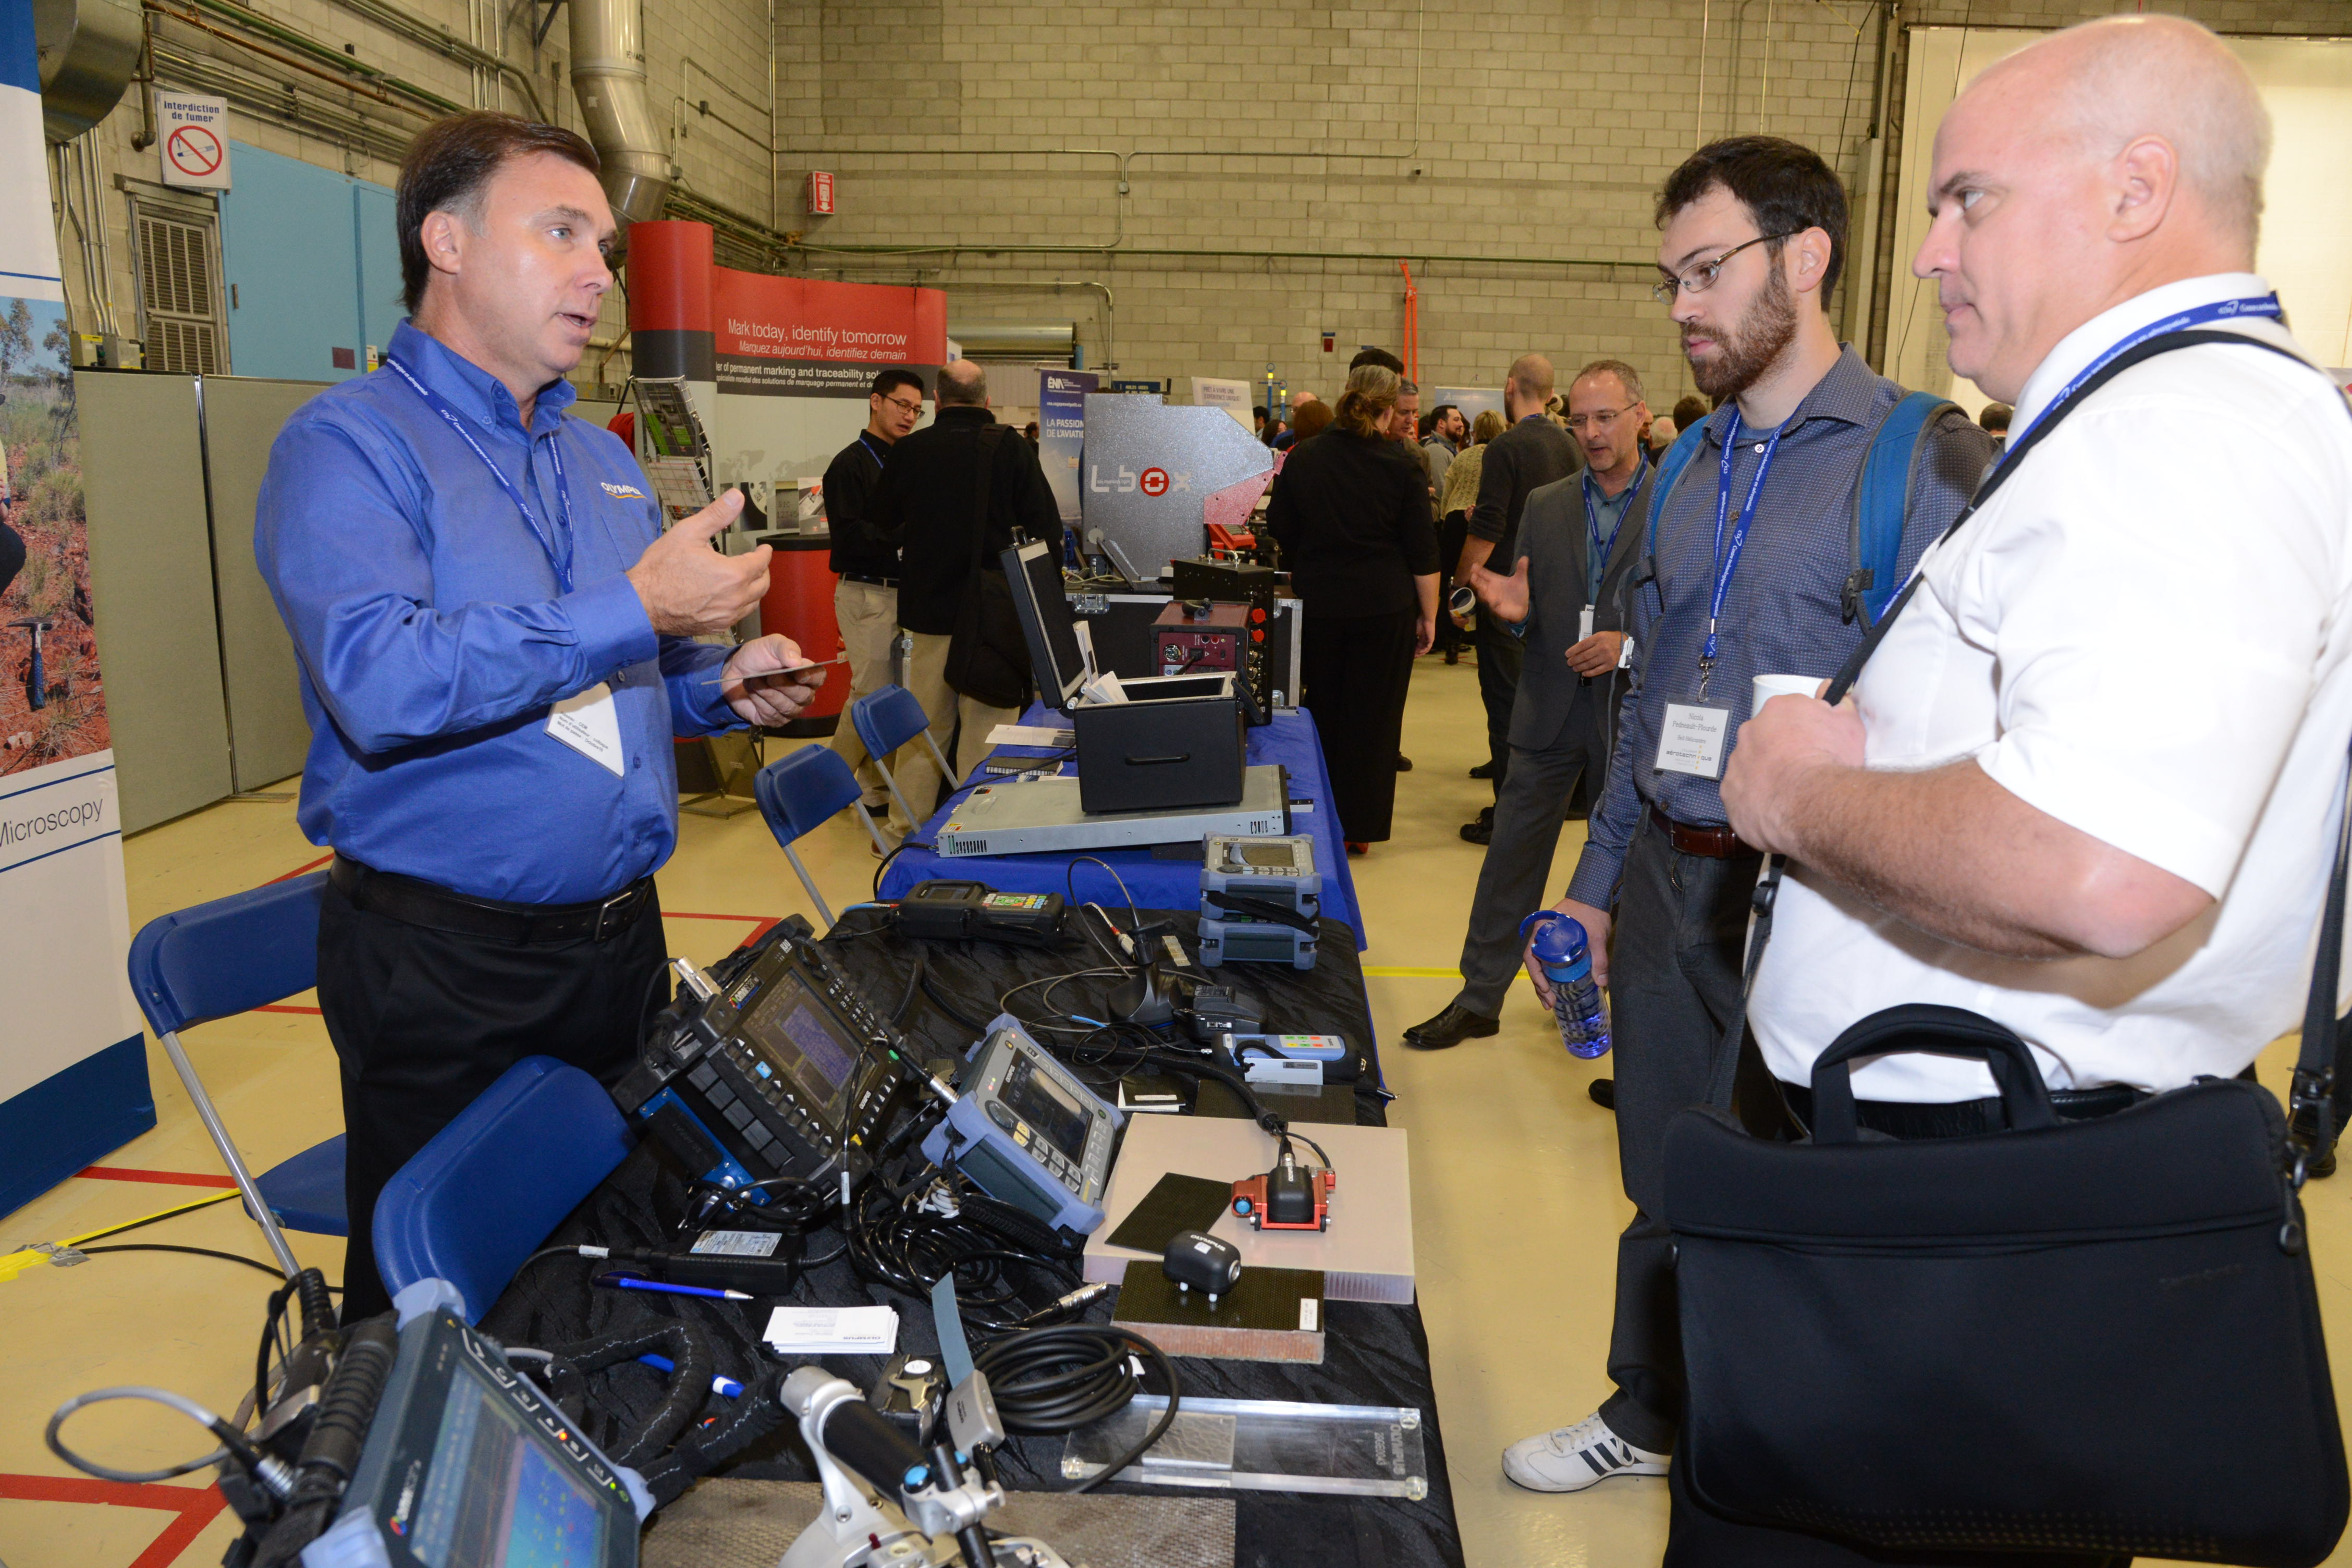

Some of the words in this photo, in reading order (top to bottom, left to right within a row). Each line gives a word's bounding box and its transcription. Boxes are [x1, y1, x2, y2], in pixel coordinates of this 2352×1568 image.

[164, 101, 219, 114] Interdiction
[172, 111, 182, 120] de
[186, 113, 214, 123] fumer
[728, 318, 751, 336] Mark
[753, 322, 788, 342] today,
[792, 325, 838, 346] identify
[842, 329, 907, 345] tomorrow
[739, 340, 770, 354] Marquez
[772, 344, 824, 358] aujourd'hui,
[826, 346, 868, 359] identifiez
[870, 349, 907, 360] demain
[724, 362, 729, 372] of
[730, 364, 762, 374] permanent
[764, 366, 796, 378] marking
[798, 368, 814, 376] and
[816, 368, 864, 381] traceability
[1047, 419, 1055, 427] LA
[1057, 419, 1084, 427] PASSION
[1729, 545, 1738, 560] Centre
[1190, 1234, 1226, 1252] OLYMPUS
[1390, 1424, 1406, 1475] OLYMPUS
